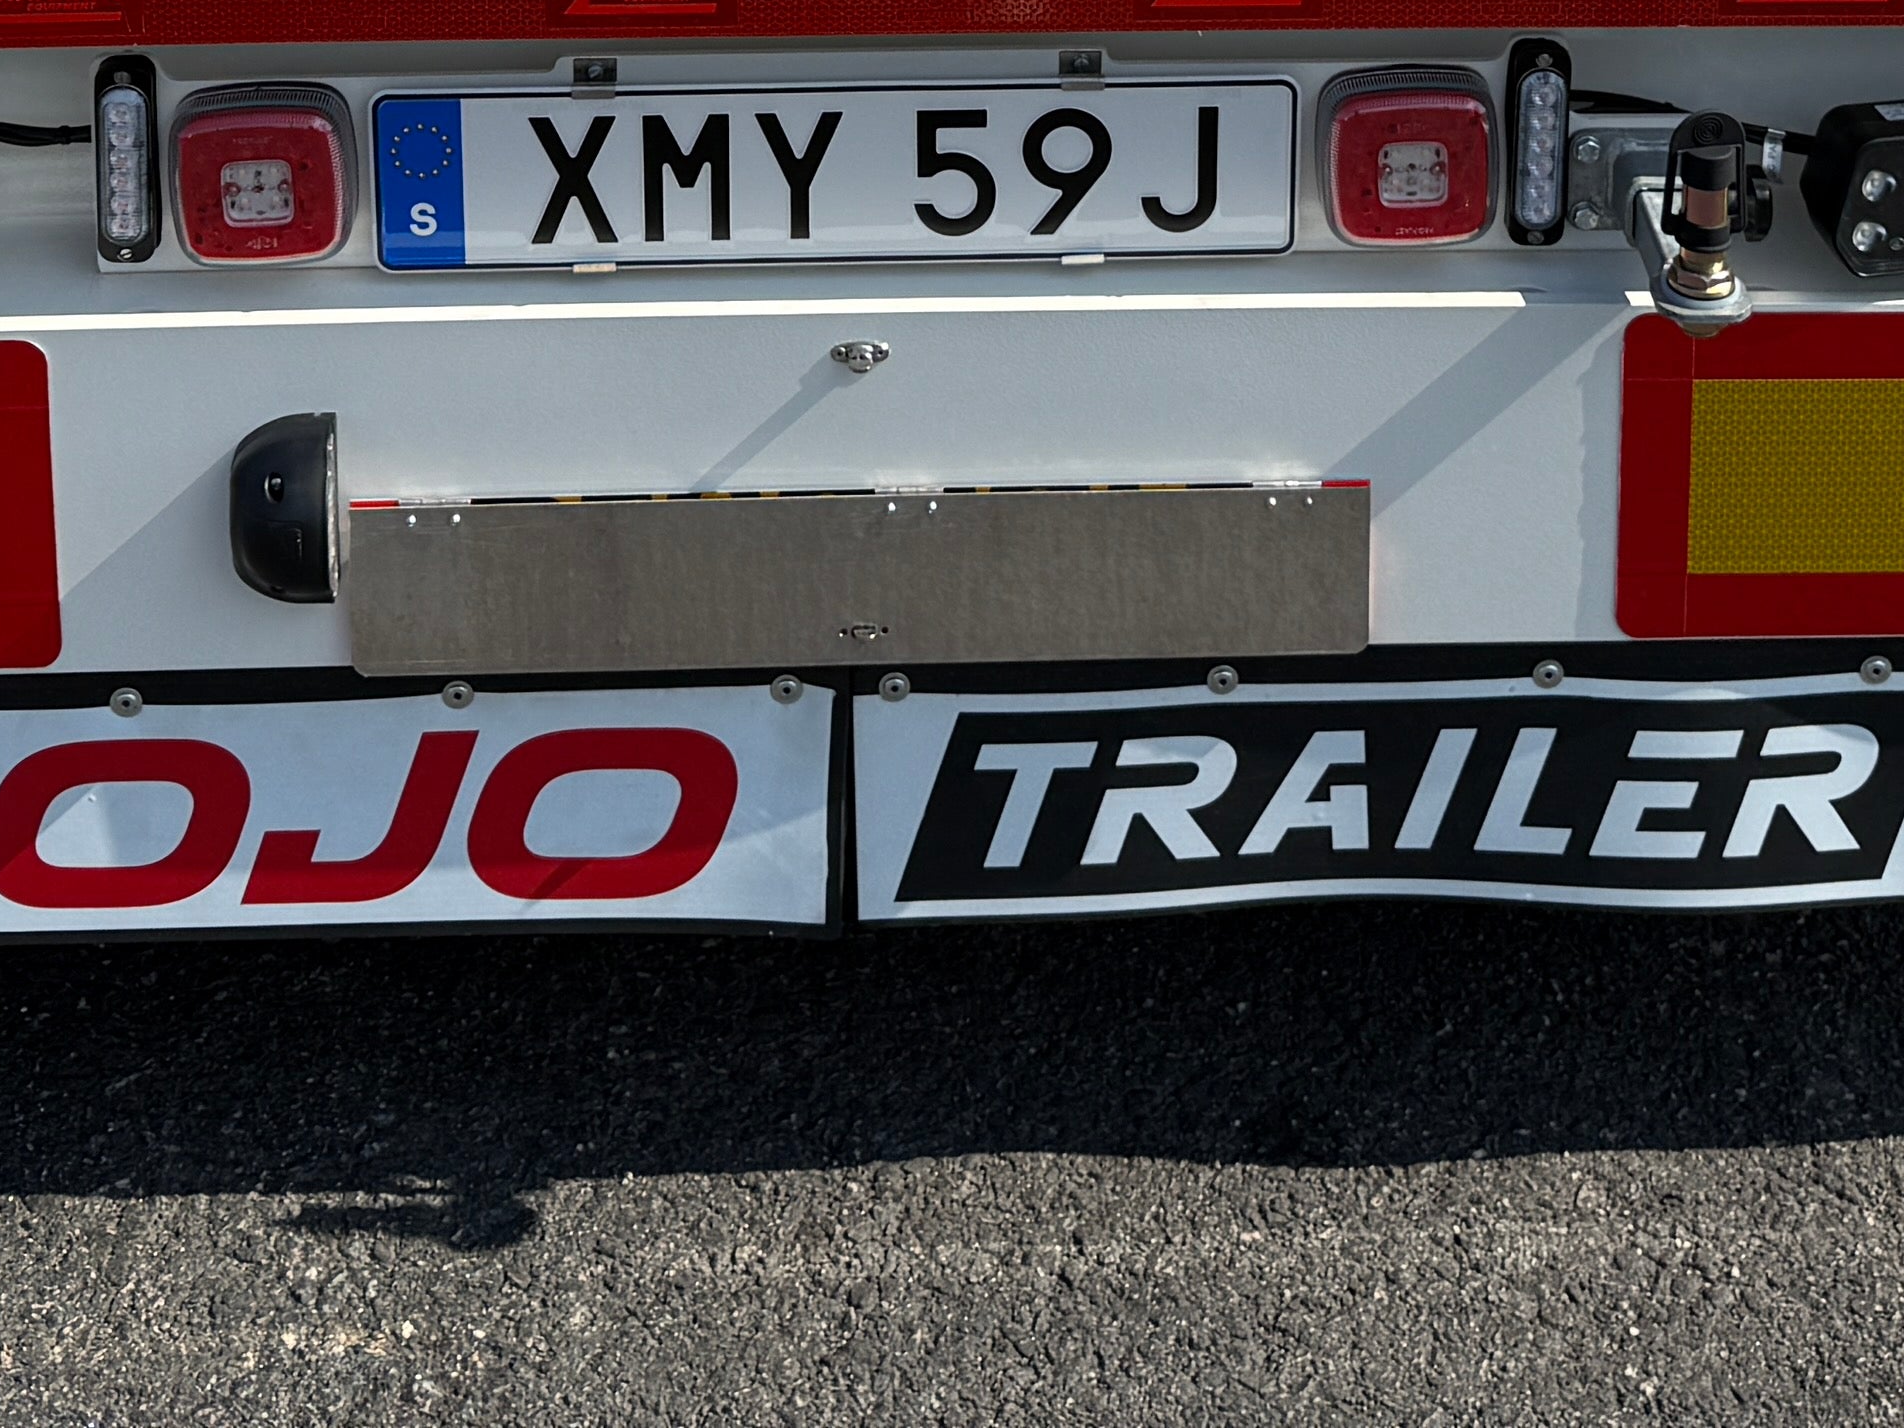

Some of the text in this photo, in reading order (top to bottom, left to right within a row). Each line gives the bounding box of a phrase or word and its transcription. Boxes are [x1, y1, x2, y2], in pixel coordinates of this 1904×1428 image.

[409, 202, 438, 236] S
[528, 106, 1220, 244] XMY 59J
[972, 722, 1881, 868] TRAILER
